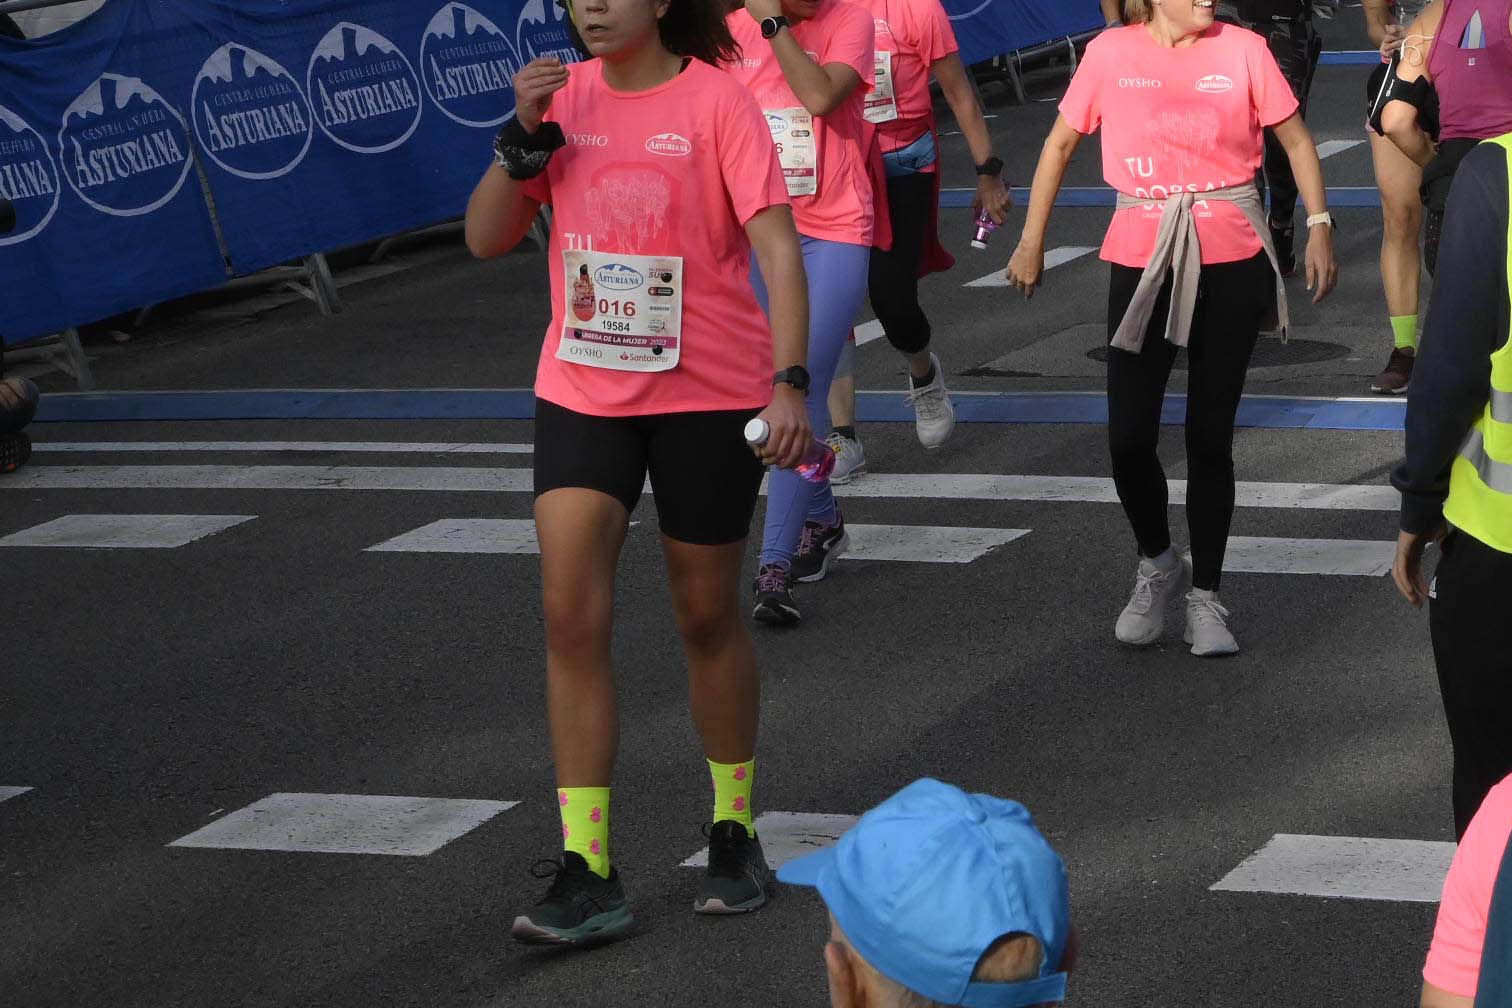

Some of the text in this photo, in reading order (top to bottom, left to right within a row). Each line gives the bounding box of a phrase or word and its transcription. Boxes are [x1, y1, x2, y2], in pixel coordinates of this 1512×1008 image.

[1118, 77, 1161, 89] OYSHO
[317, 76, 418, 127] ASTURIANA
[203, 99, 308, 152] ASTURIANA
[70, 128, 185, 189] ASTURIANA
[1124, 156, 1154, 179] TU
[597, 272, 639, 285] ASTURIANA
[598, 298, 636, 317] 016
[602, 320, 631, 332] 19584
[613, 335, 621, 343] LA
[622, 336, 648, 345] MUJER
[570, 345, 603, 359] OYSHO
[629, 353, 669, 363] Santander
